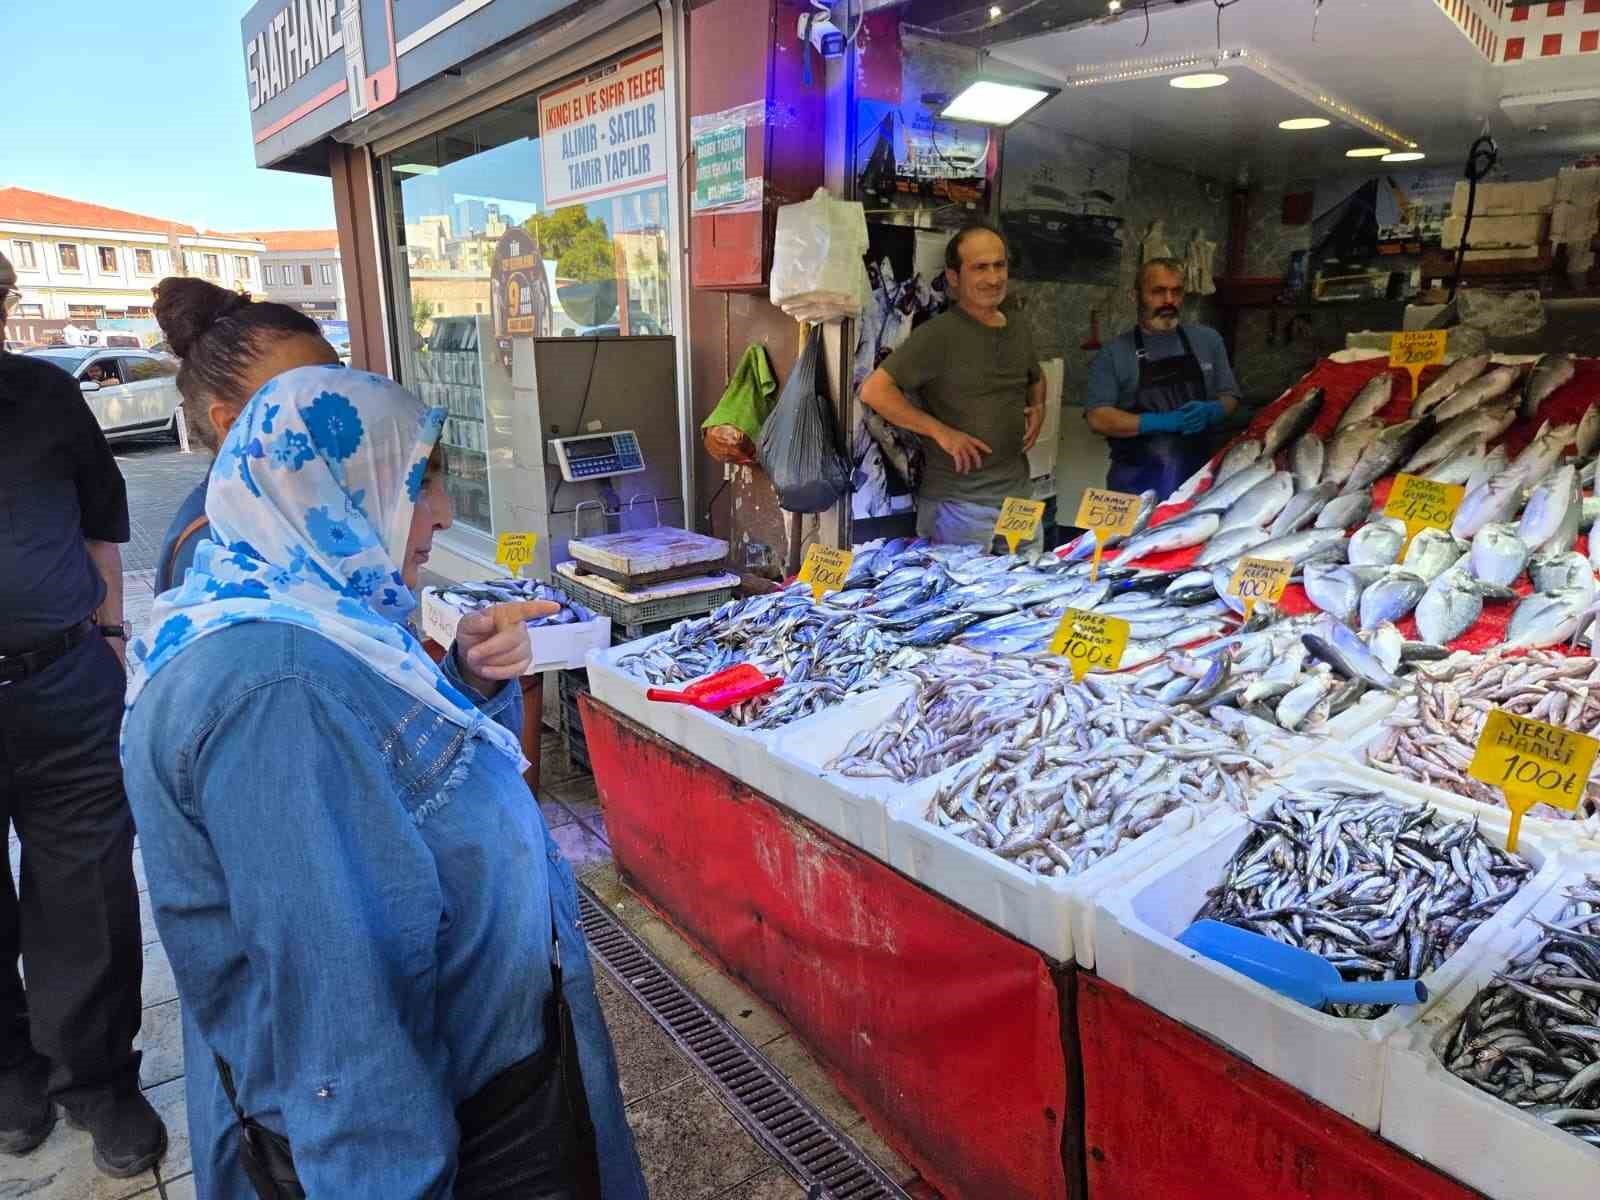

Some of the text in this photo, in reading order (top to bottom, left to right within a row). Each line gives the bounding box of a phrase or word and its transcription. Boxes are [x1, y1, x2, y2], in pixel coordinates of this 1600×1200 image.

[247, 0, 344, 112] SAATHANE
[573, 96, 584, 121] EL
[586, 91, 598, 117] VE
[600, 80, 625, 112] SIFIR
[562, 123, 597, 160] ALINIR
[608, 103, 656, 146] SATILIR
[568, 143, 652, 191] TAMİR YAPILIR
